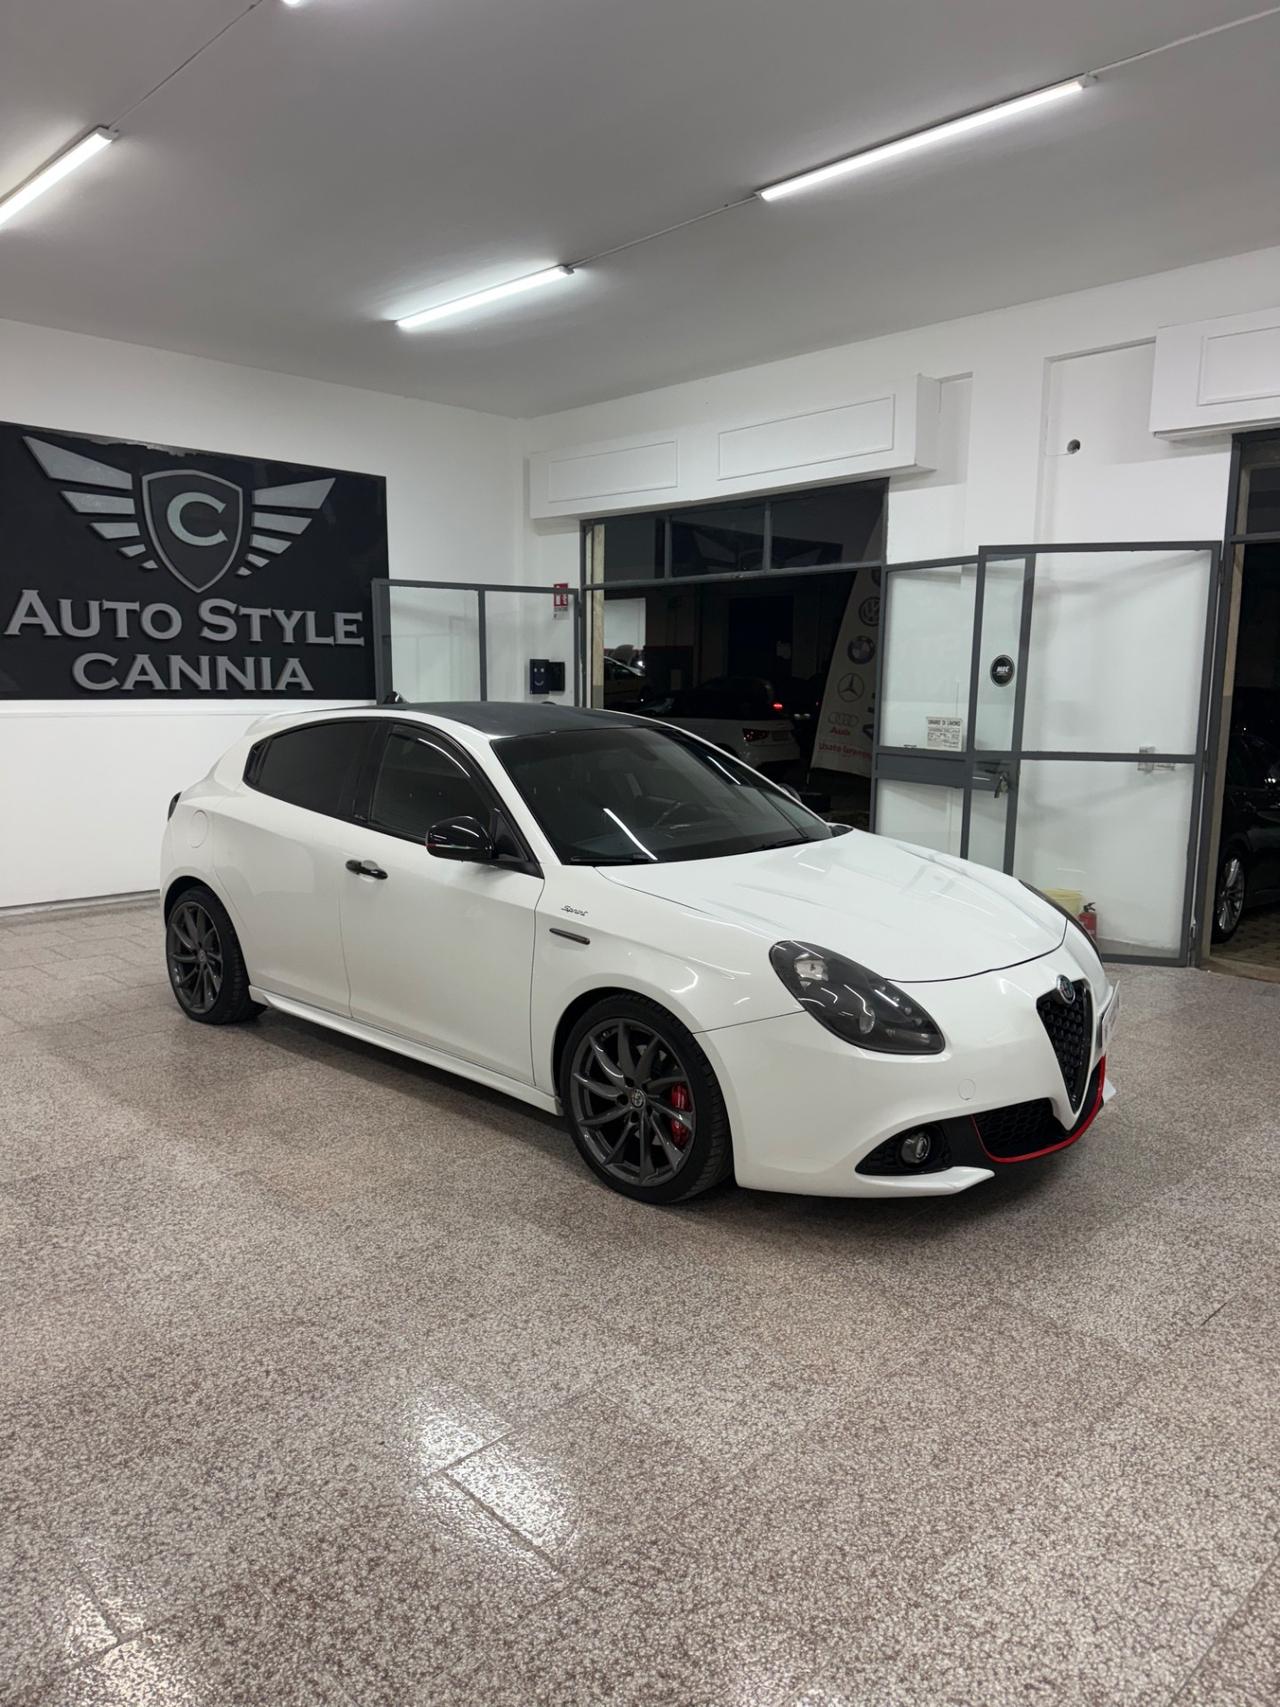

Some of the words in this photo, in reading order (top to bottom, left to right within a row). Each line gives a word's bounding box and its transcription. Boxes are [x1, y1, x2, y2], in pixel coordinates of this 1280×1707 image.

[166, 491, 228, 547] C
[3, 588, 183, 640] AUTO
[198, 597, 365, 648] STYLE
[71, 651, 315, 693] CANNIA
